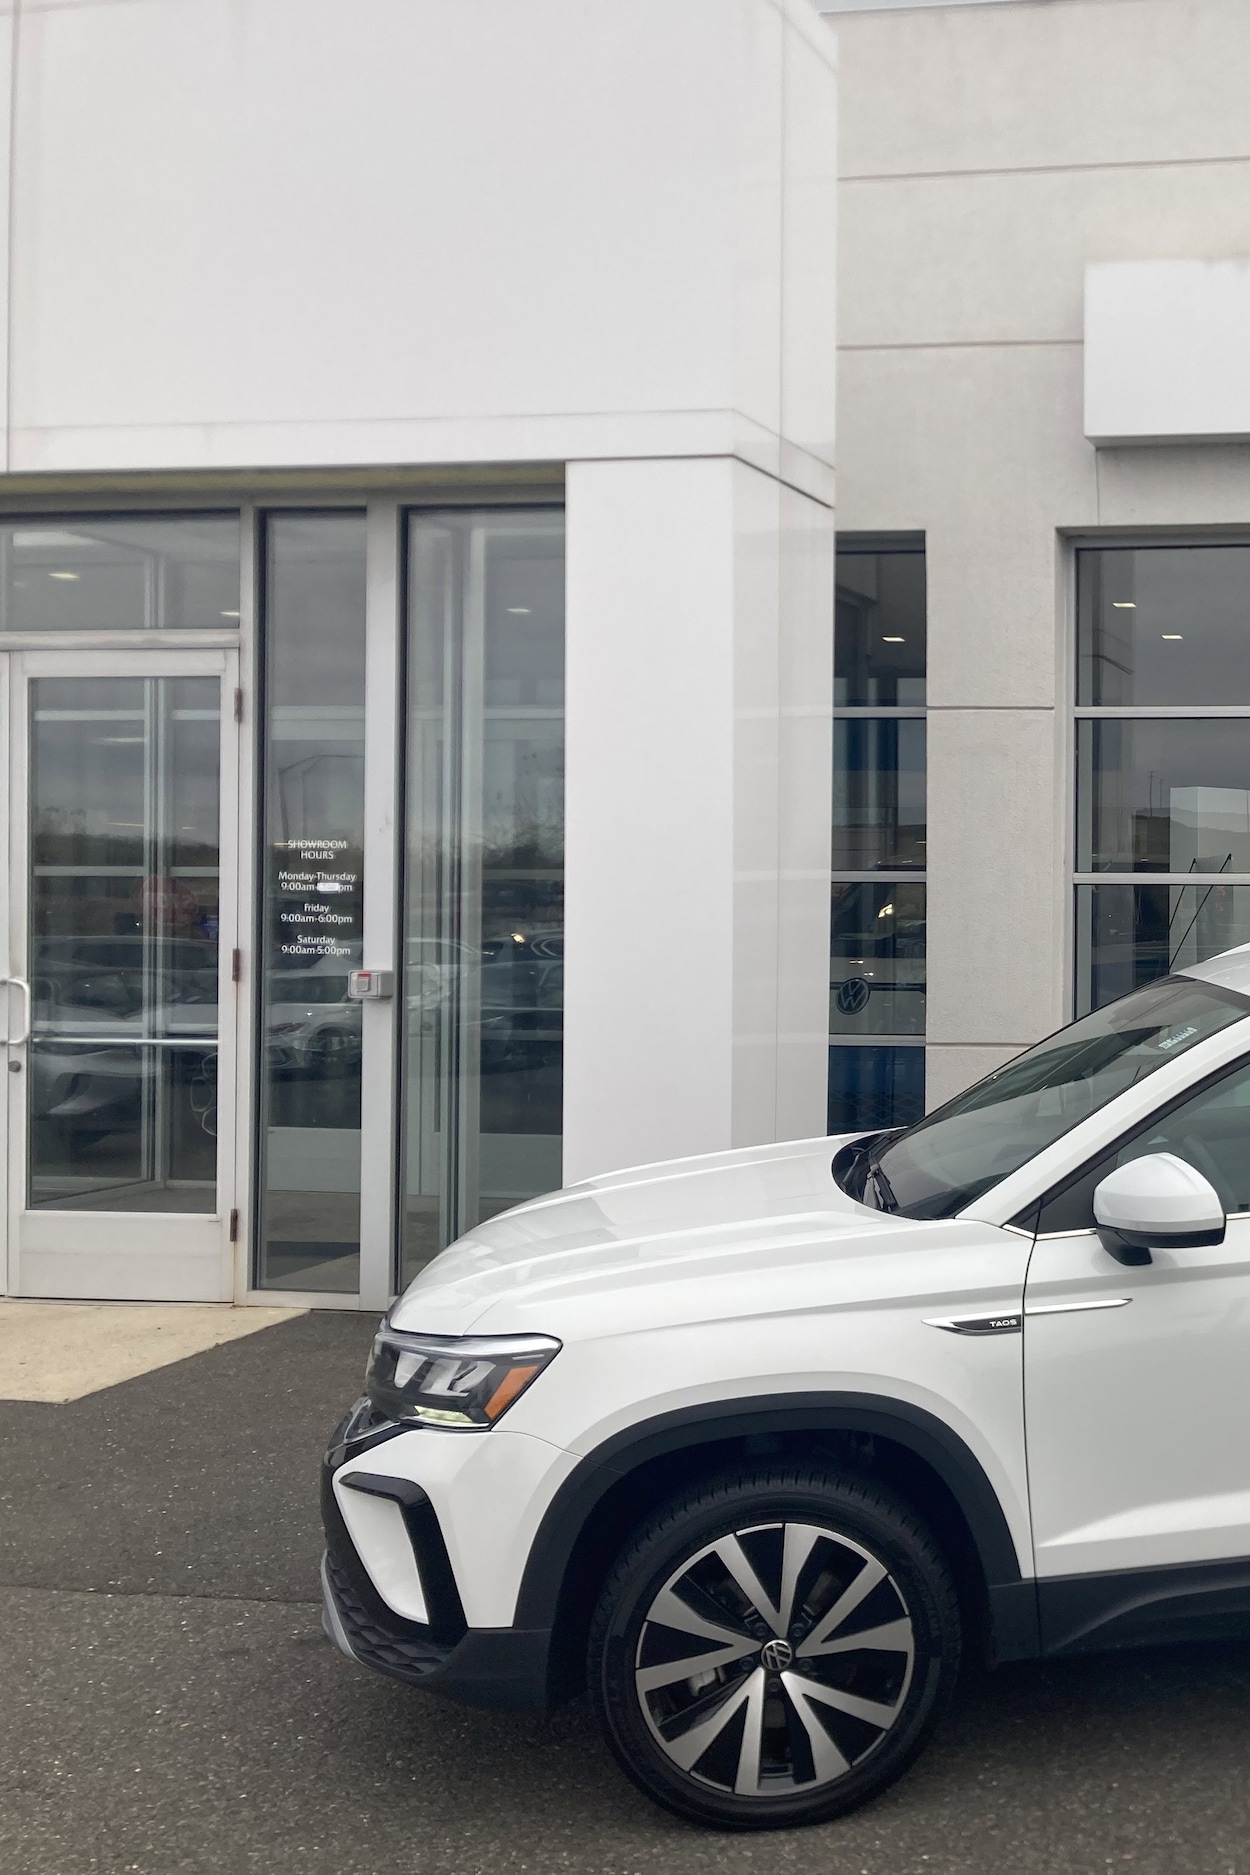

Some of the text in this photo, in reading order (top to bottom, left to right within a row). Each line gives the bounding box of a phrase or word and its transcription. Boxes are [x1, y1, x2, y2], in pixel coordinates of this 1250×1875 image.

[287, 840, 347, 849] SHOWROOM
[300, 851, 334, 860] HOURS
[278, 871, 356, 882] Monday-Thursday
[304, 903, 330, 914] Friday
[280, 913, 353, 925] 9:00am-6:00pm
[297, 935, 336, 946] Saturday
[281, 945, 351, 957] 9:00am-5:00pm
[989, 1319, 1017, 1327] TAOS
